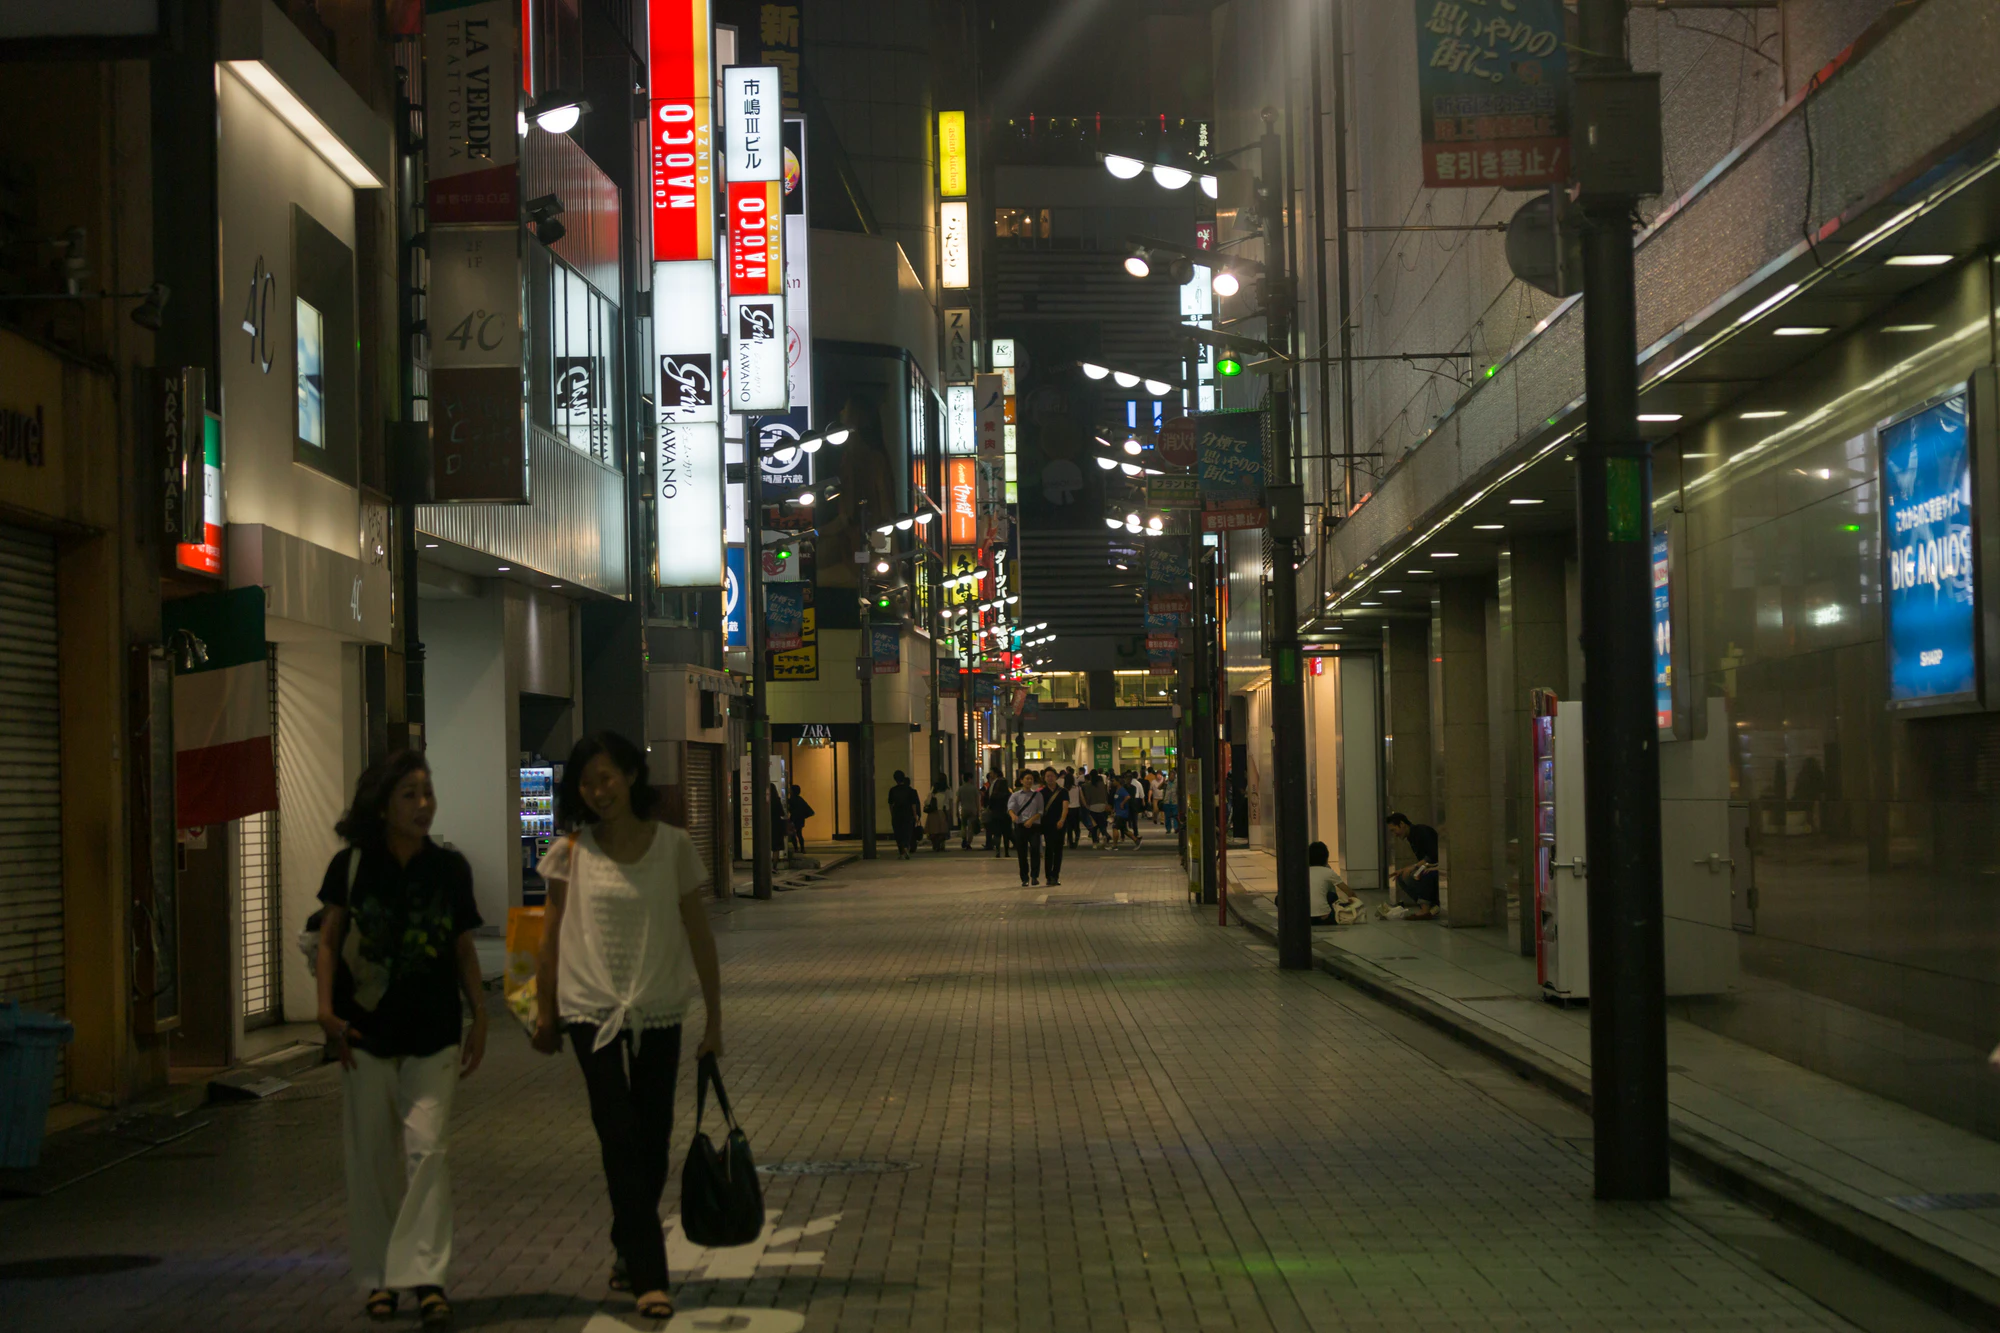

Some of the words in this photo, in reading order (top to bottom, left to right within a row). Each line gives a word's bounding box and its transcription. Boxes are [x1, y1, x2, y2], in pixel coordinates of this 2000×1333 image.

[466, 19, 489, 57] LA
[1424, 0, 1557, 58] 思いやりの
[1430, 37, 1503, 85] 街に。
[447, 21, 462, 158] TRATTORIA
[467, 66, 491, 160] VERDE
[660, 104, 695, 208] NAOCO
[698, 124, 709, 184] GINZA
[948, 127, 957, 152] asian
[655, 147, 667, 208] COUTURE
[949, 155, 958, 188] kitchen
[1436, 147, 1562, 180] 客引き禁止!
[735, 230, 745, 278] COUTURE
[738, 198, 766, 278] NAOCO
[770, 214, 779, 260] GINZA
[950, 312, 966, 377] ZARA
[739, 343, 751, 403] KAWANO
[661, 412, 678, 499] KAWANO
[1201, 431, 1247, 453] 分煙で
[1201, 450, 1260, 474] 思いやりの
[762, 474, 803, 483] 酒屋六蔵
[1203, 464, 1236, 485] 街に。
[1207, 513, 1261, 528] 客引き禁止!
[1891, 545, 1916, 590] BIG
[1917, 532, 1969, 590] AQUOS
[774, 664, 815, 675] ライオン
[802, 724, 832, 738] ZARA
[1096, 741, 1109, 749] JR
